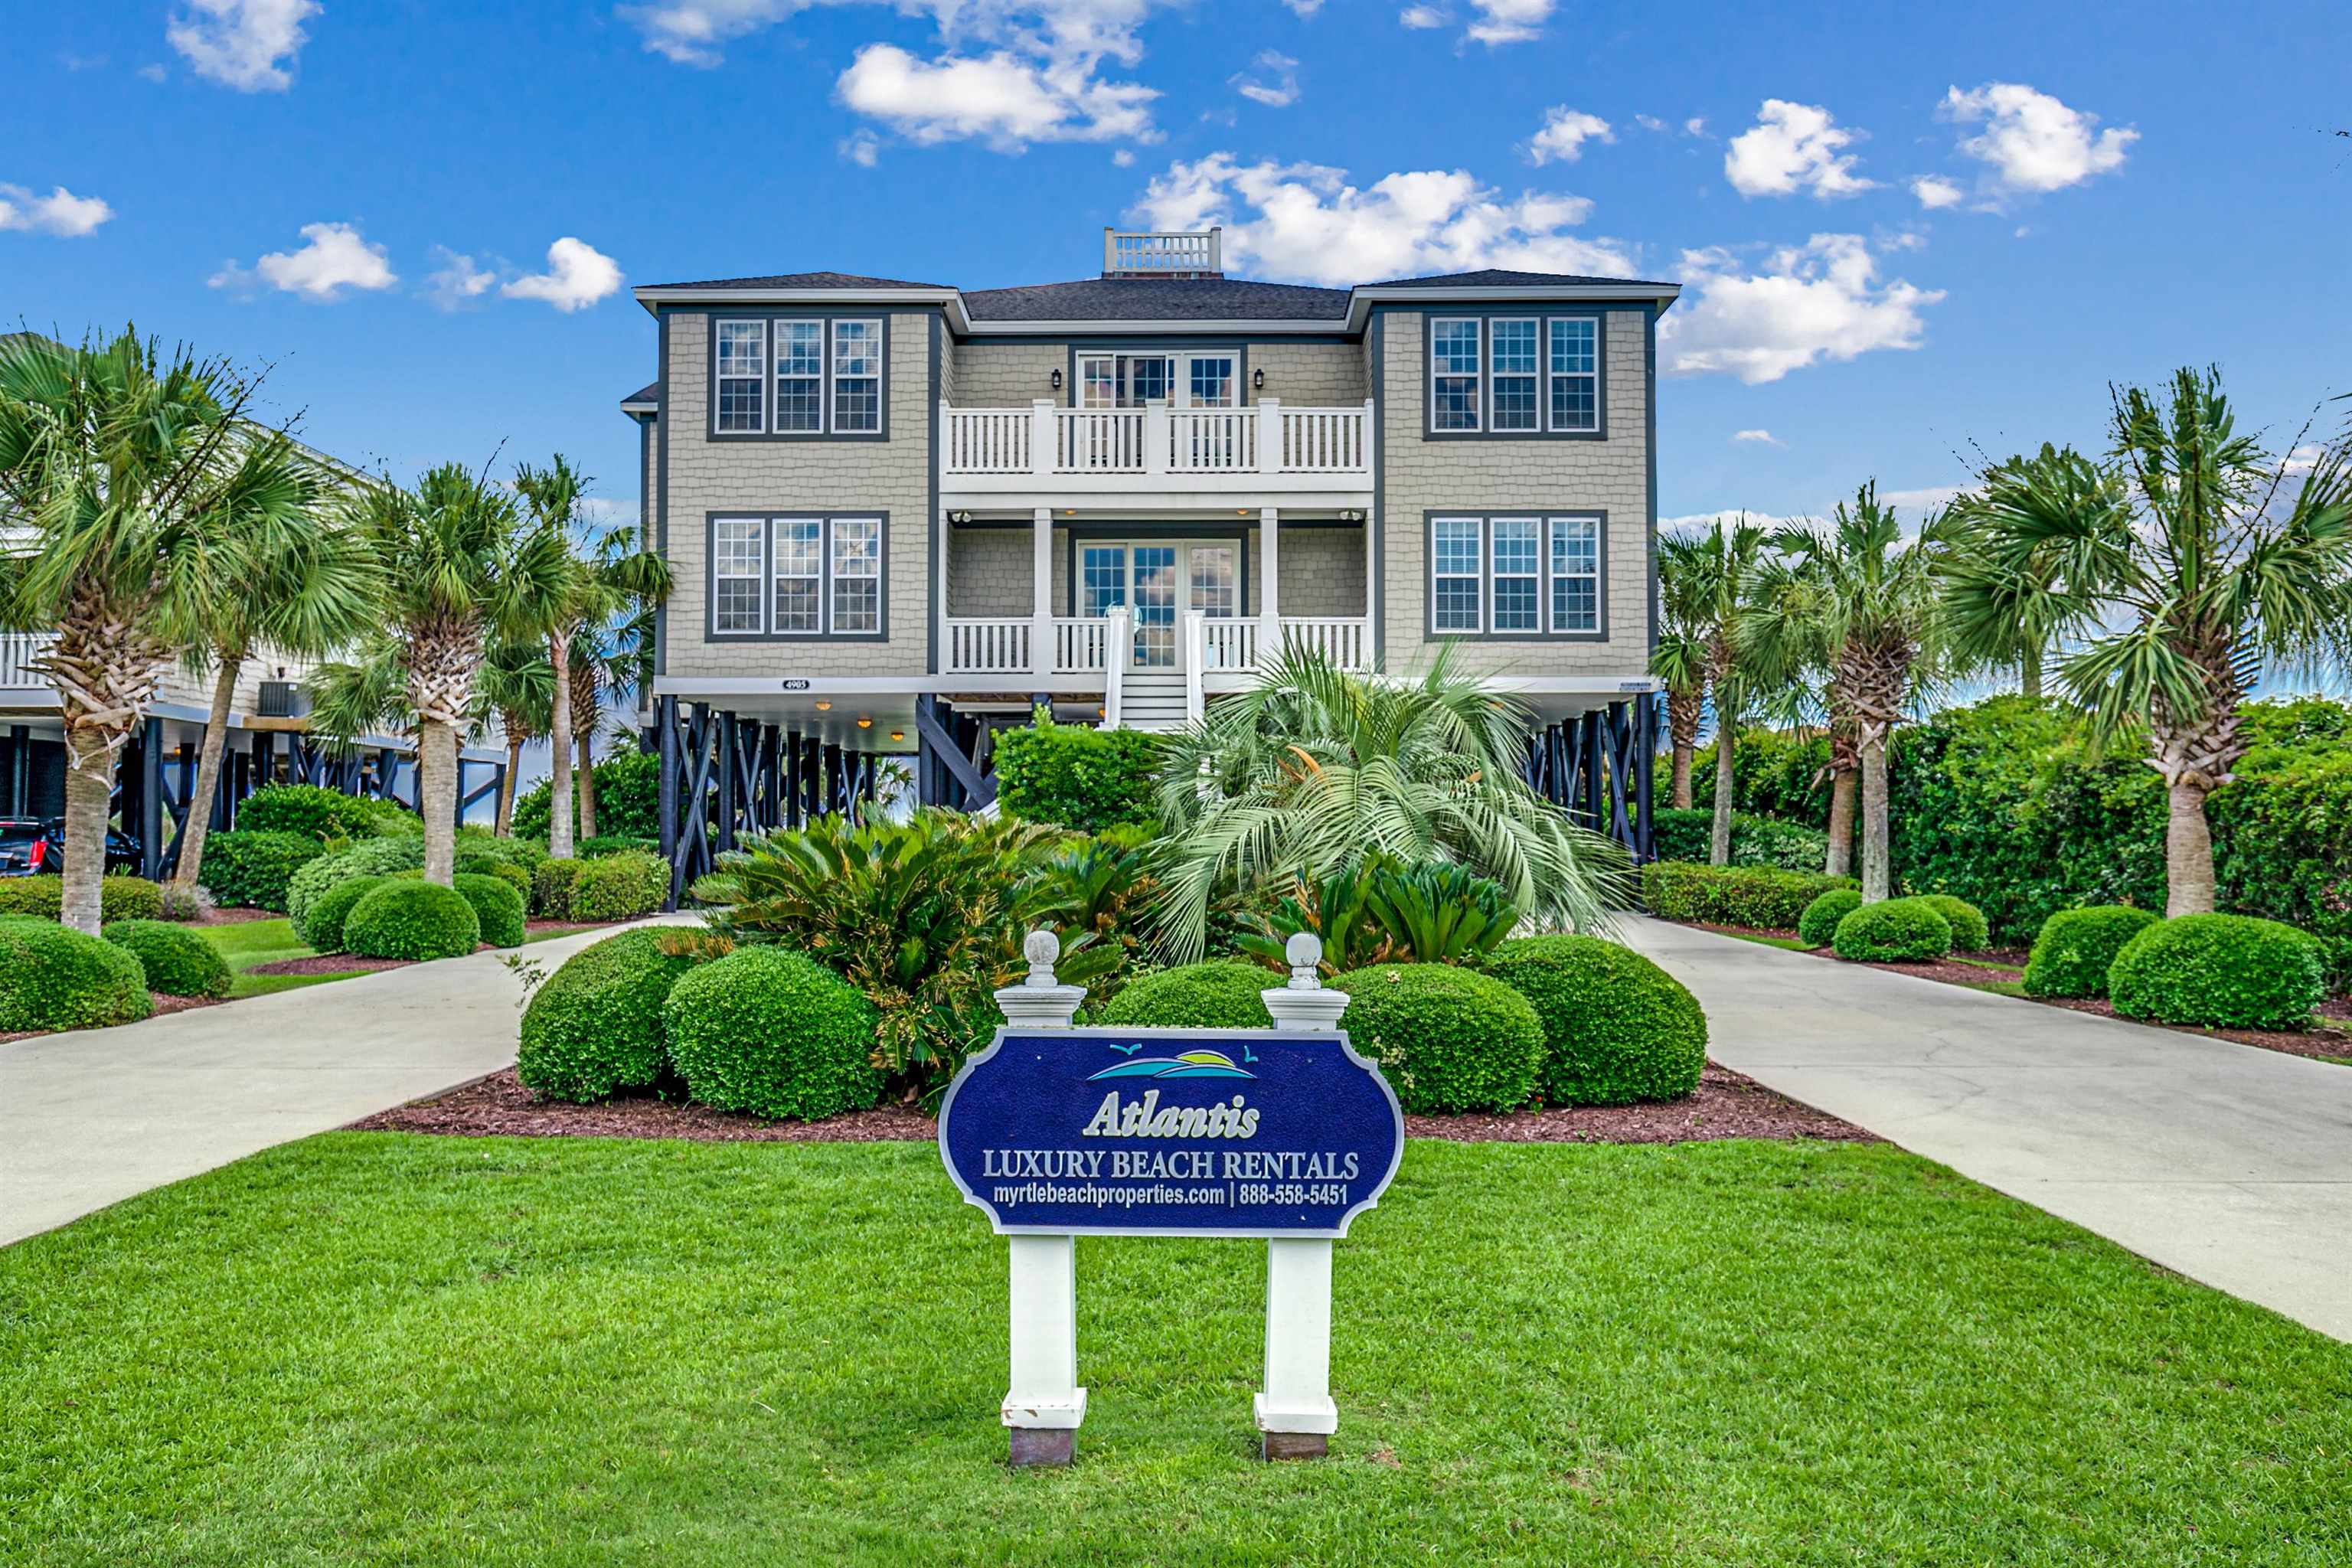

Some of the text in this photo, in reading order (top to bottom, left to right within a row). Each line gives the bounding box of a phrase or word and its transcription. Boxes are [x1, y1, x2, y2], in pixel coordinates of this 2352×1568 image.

[1082, 1089, 1260, 1138] Atlantis
[983, 1150, 1360, 1180] LUXURY BEACH RENTALS
[993, 1182, 1225, 1208] myrtlebeachproperties.com
[1239, 1184, 1348, 1206] 888-558-5451
